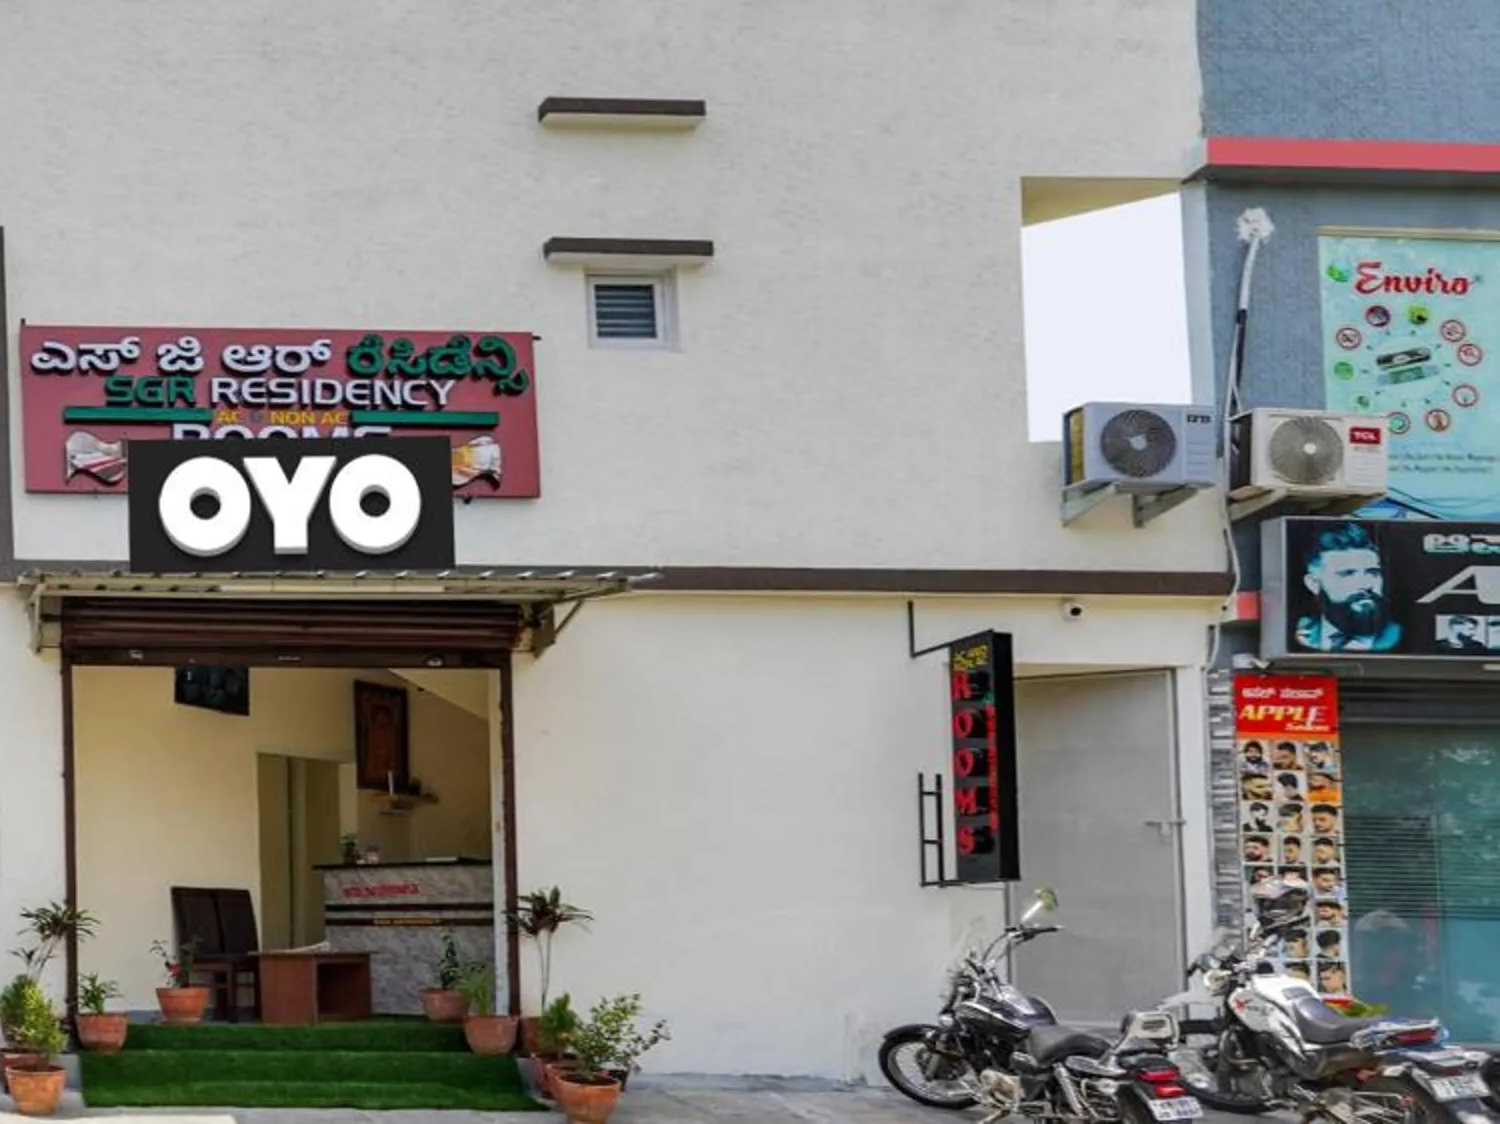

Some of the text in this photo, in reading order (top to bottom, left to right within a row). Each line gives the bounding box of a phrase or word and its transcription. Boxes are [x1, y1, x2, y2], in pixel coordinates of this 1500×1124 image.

[1355, 261, 1470, 295] Enviro
[31, 336, 141, 372] ಎಸ್
[157, 336, 205, 373] ಜಿ
[222, 339, 332, 374] ಆರ್
[105, 376, 457, 406] SGR RESIDENCY
[216, 411, 243, 424] AC
[270, 411, 316, 425] NON
[320, 411, 348, 425] AC
[158, 454, 422, 557] OYO
[1239, 705, 1329, 727] APPLE
[951, 670, 977, 855] ROOMS
